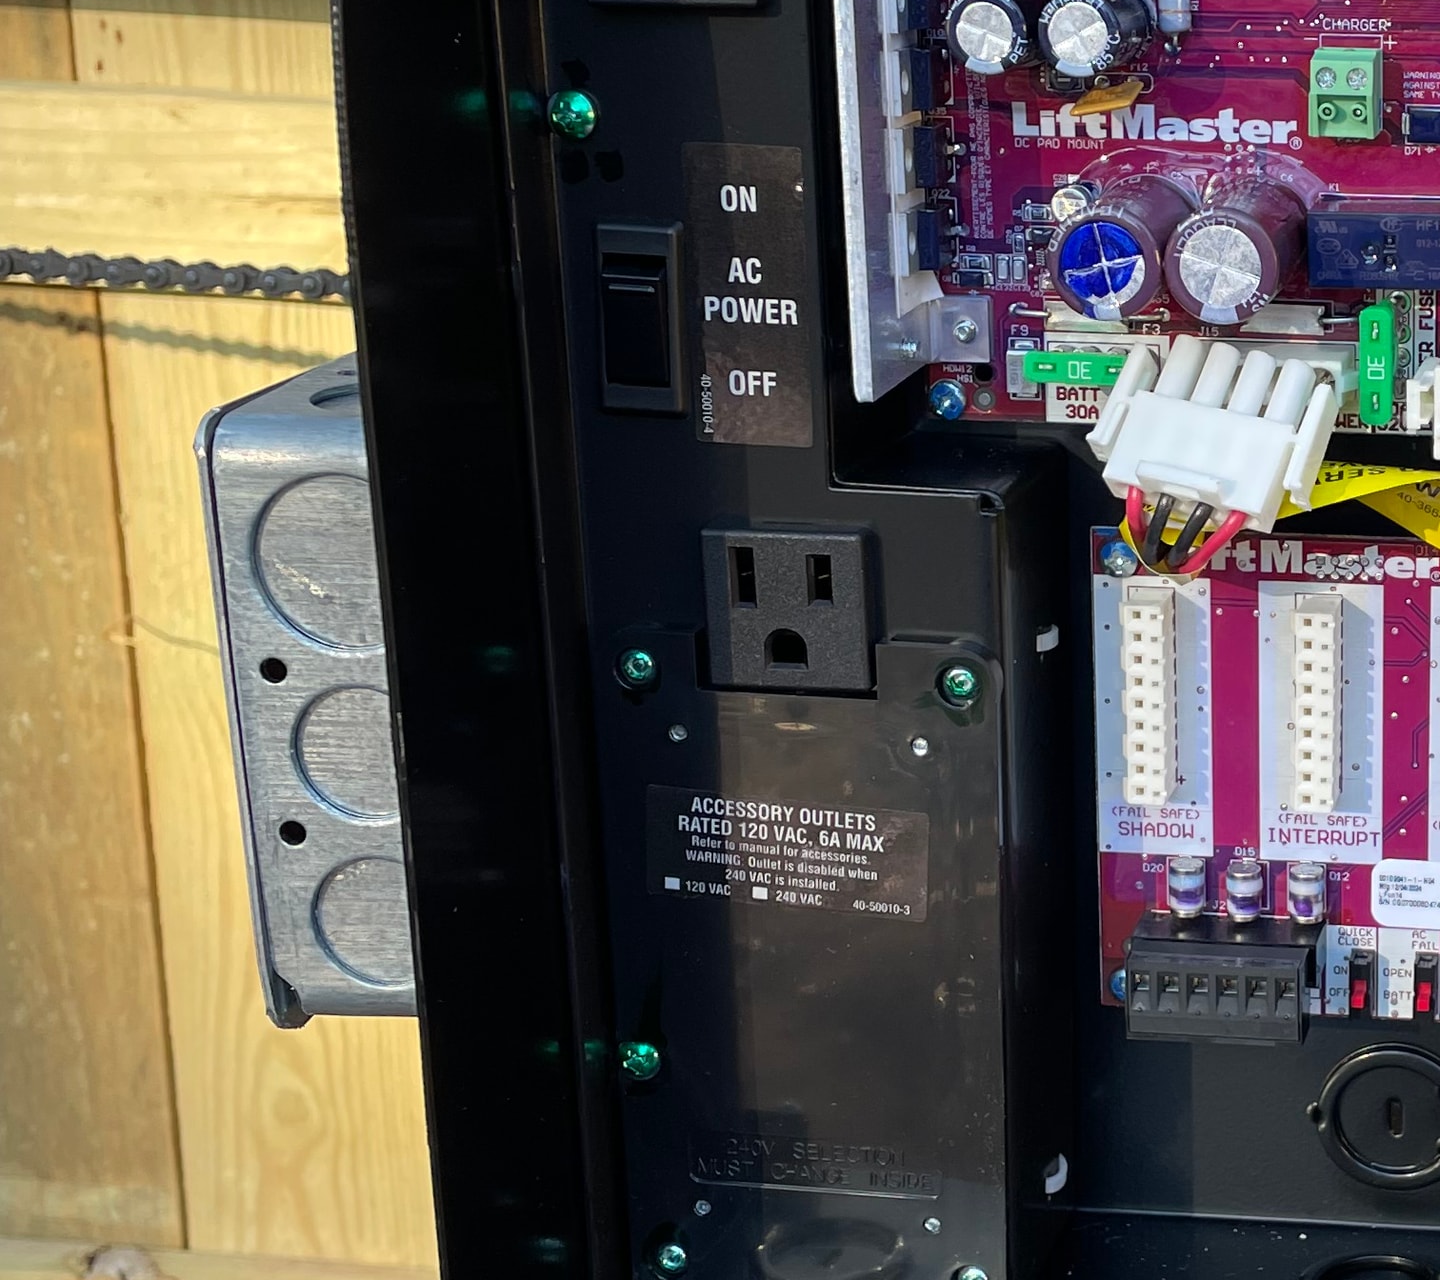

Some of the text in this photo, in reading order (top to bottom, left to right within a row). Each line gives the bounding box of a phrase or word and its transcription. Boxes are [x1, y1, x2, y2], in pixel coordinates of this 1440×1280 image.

[1322, 19, 1387, 32] CHARGER
[1403, 82, 1440, 90] AGAINST
[1403, 91, 1424, 99] SAME
[1011, 102, 1297, 142] LiftMaster
[1014, 138, 1105, 149] DC PAD MOUNT
[720, 185, 757, 212] ON
[728, 257, 762, 284] AC
[703, 296, 798, 325] POWER
[728, 369, 777, 396] OFF
[1056, 387, 1100, 402] BATT
[1065, 404, 1100, 419] 30A
[691, 797, 876, 832] ACCESSORY OUTLETS
[1112, 806, 1200, 820] (FAIL SAFE)
[1278, 813, 1367, 828] (FAIL SAFE)
[678, 815, 885, 852] RATED 120 VAC, 6A MAX
[1118, 822, 1195, 839] SHADOW
[1269, 827, 1381, 847] INTERRUPT
[691, 835, 871, 865] Refer to manual for accessories.
[685, 850, 878, 881] WARNING: Outlet is disabled when
[685, 880, 732, 896] 120 VAC
[725, 869, 840, 891] 240 VAC is installed.
[775, 890, 823, 906] 240 VAC
[852, 899, 911, 916] 40-50010-3
[1338, 927, 1373, 937] QUICK
[1337, 936, 1374, 947] CLOSE
[1412, 940, 1439, 951] FAIL
[792, 1142, 905, 1167] SELECTION
[698, 1157, 933, 1191] MUST CHANGE INSIDE
